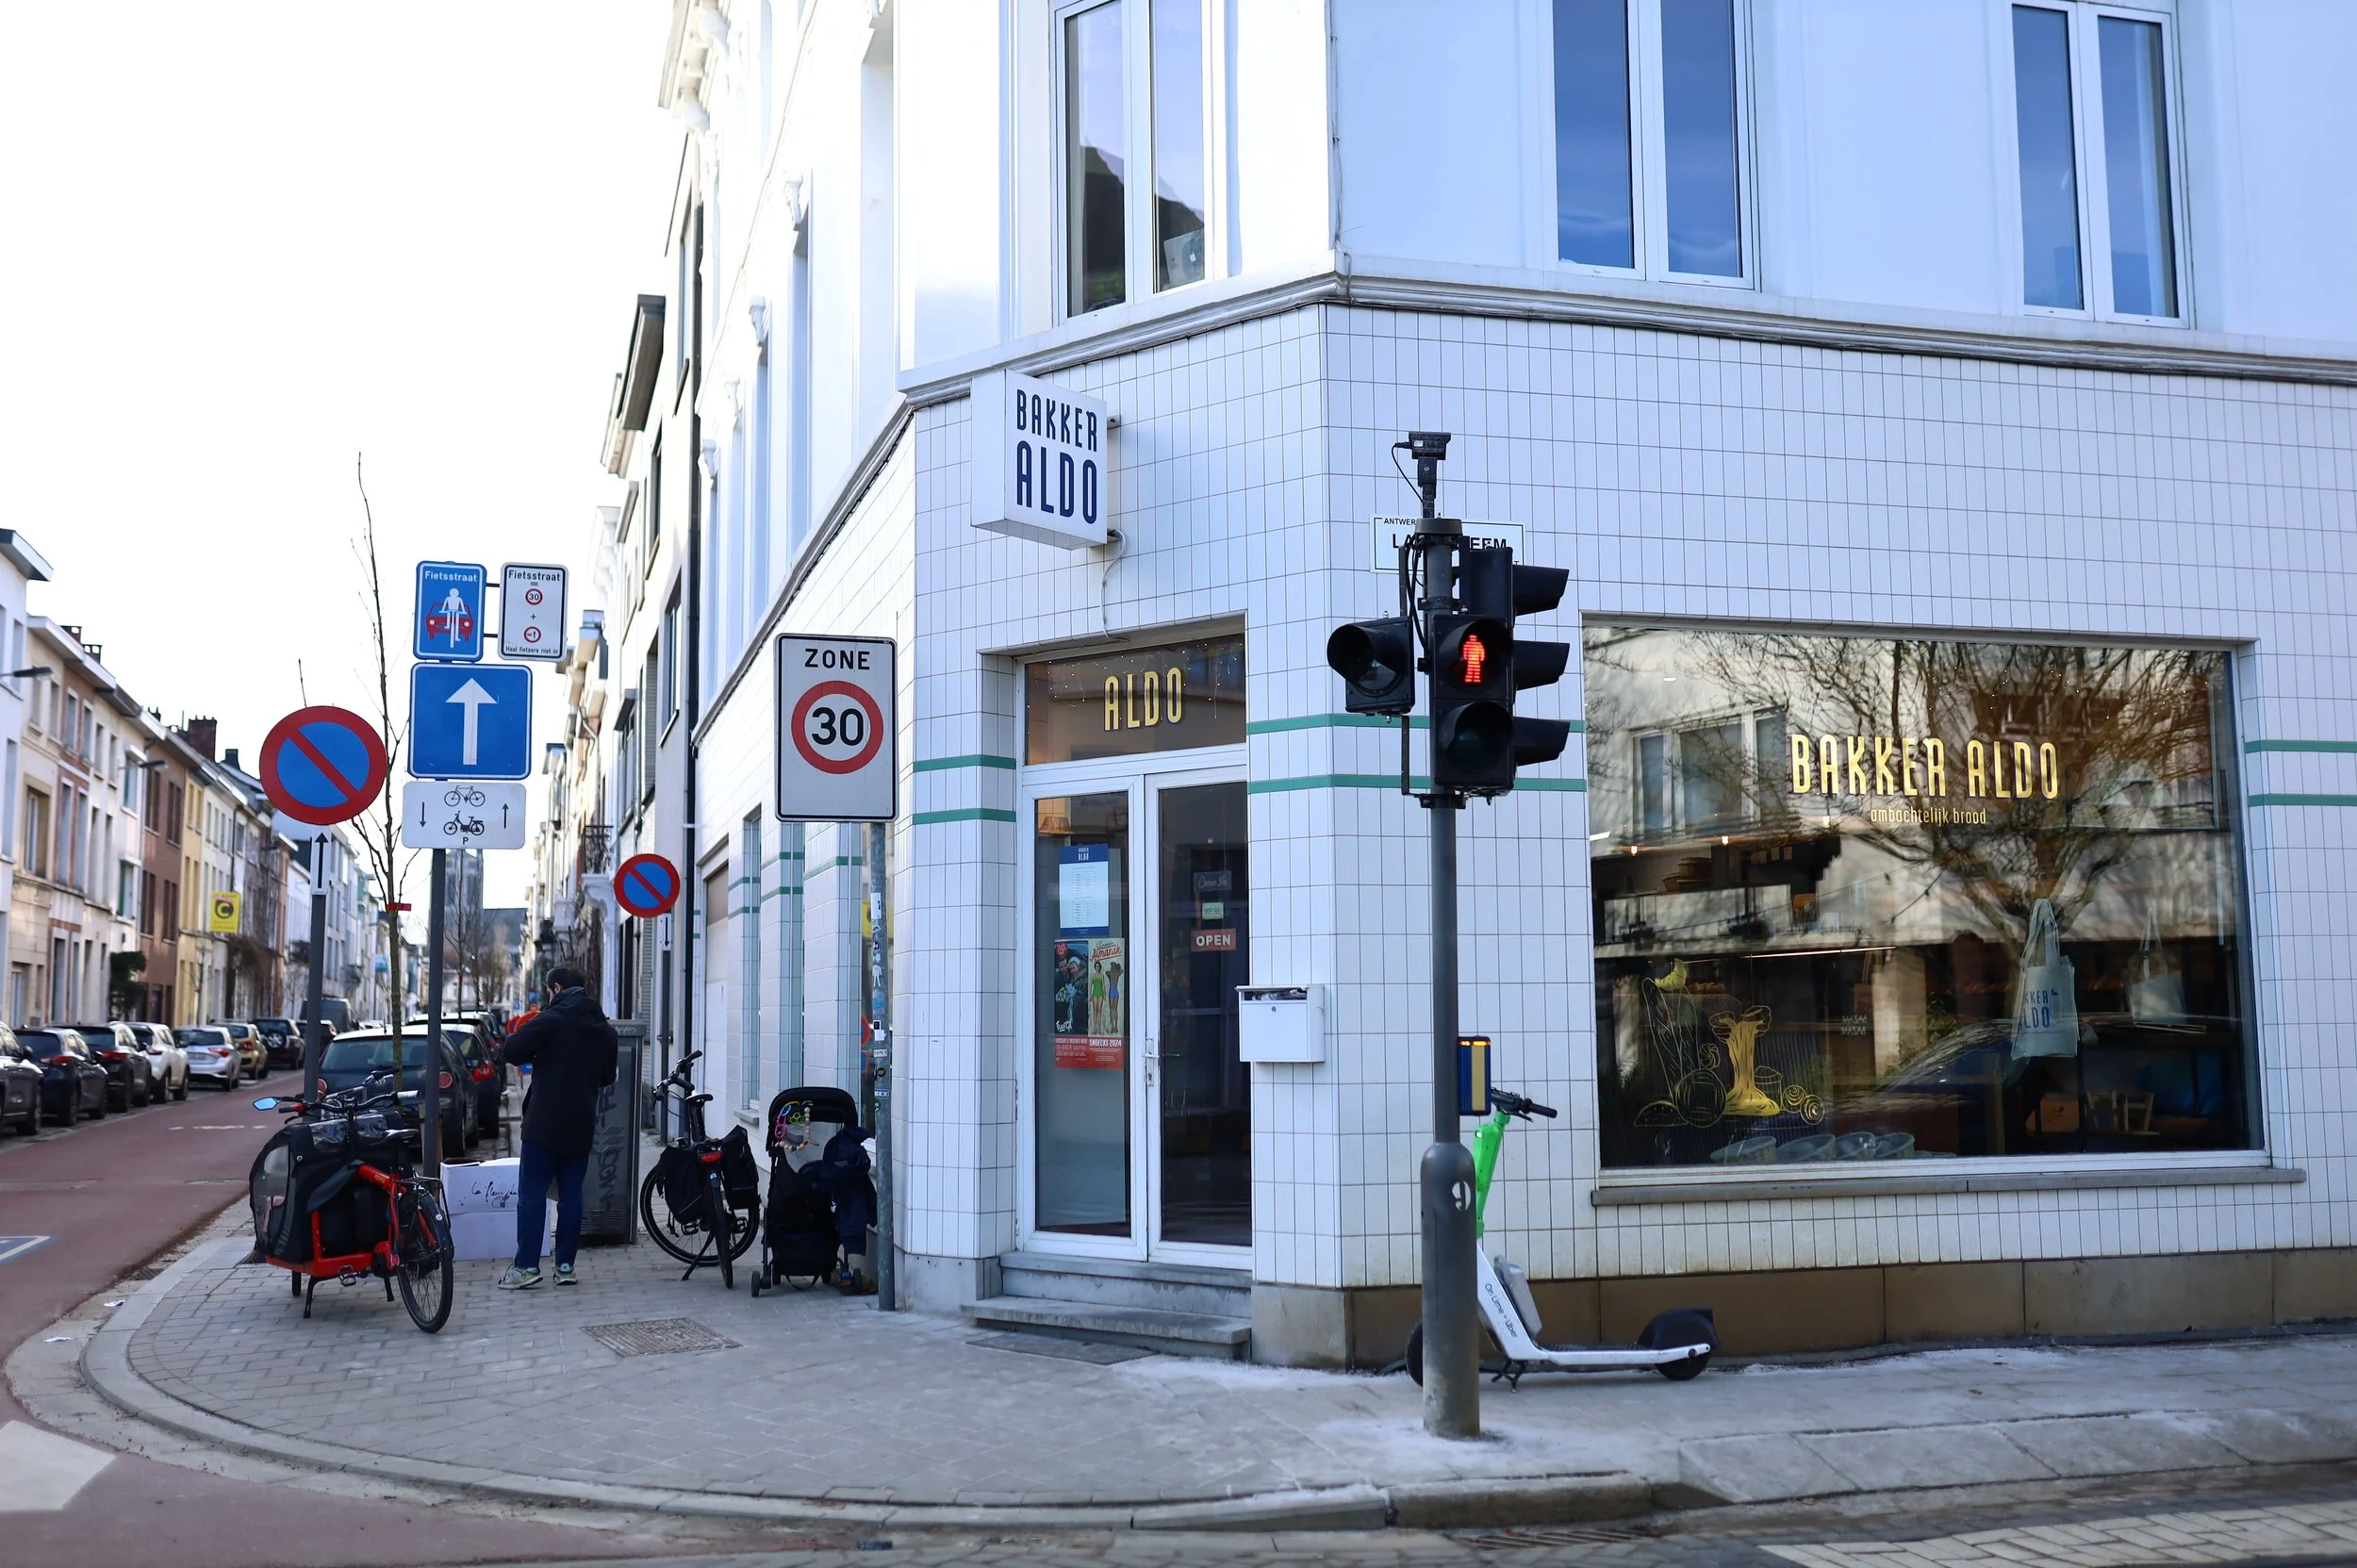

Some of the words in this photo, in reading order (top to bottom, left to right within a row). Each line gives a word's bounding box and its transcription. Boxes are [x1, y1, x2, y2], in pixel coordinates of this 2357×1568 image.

[1016, 388, 1097, 453] BAKKER
[1016, 440, 1097, 524] ALDO
[1383, 518, 1416, 526] ANTWER
[424, 570, 478, 582] Fietsstraat
[508, 569, 561, 582] Fietsstraat
[804, 648, 870, 670] ZONE
[1104, 667, 1182, 732] ALDO
[812, 707, 864, 746] 30
[1790, 734, 1947, 797] BAKKER
[1967, 739, 2059, 800] ALDO
[1870, 805, 1949, 827] ambachtelijk
[1953, 807, 1986, 824] brood
[462, 836, 470, 845] P
[1195, 934, 1231, 947] OPEN
[1090, 944, 1122, 961] Almanak
[1089, 1038, 1109, 1047] SNOECKS
[1109, 1039, 1122, 1048] 2024
[1484, 1283, 1494, 1295] On
[1492, 1296, 1505, 1314] Lime
[1505, 1320, 1518, 1338] Uber
